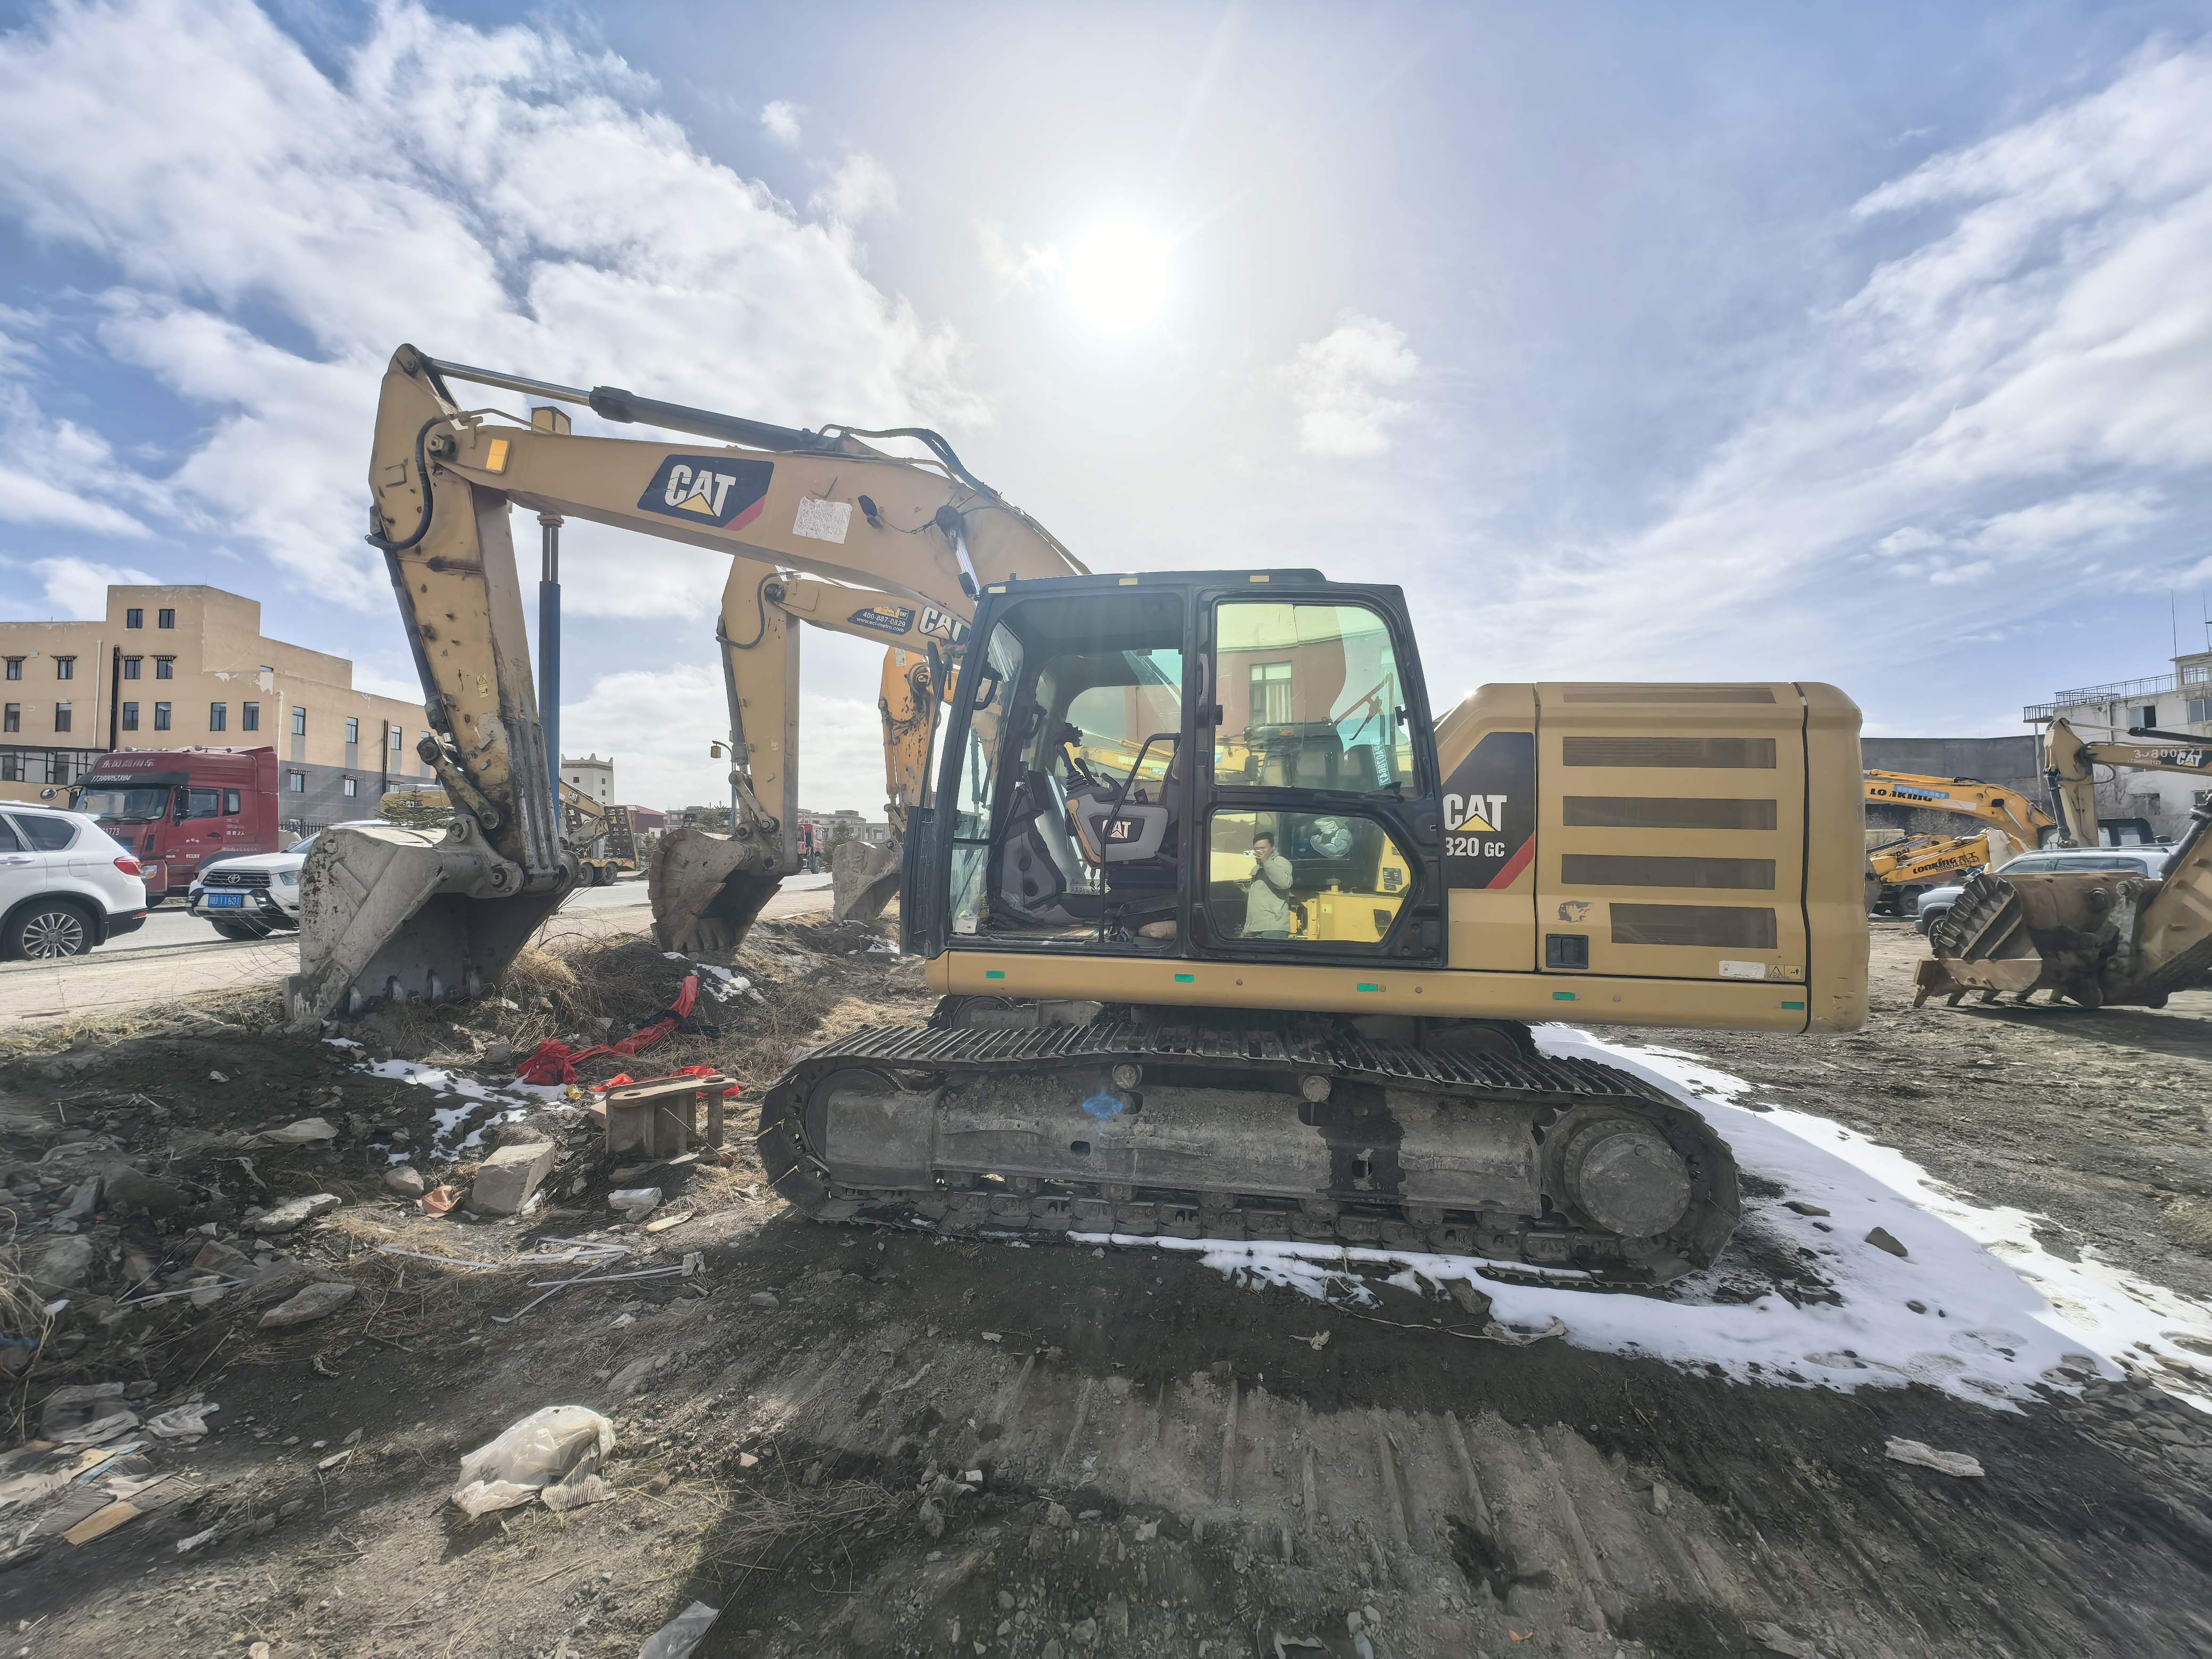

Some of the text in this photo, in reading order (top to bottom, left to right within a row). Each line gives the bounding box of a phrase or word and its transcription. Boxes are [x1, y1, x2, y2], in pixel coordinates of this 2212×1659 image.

[665, 464, 736, 517] CAT
[919, 606, 962, 642] CAT
[2176, 751, 2201, 767] CAT
[568, 791, 578, 802] CAT
[1442, 793, 1507, 832] CAT
[102, 827, 120, 836] 1773
[1445, 836, 1505, 857] 320 GC
